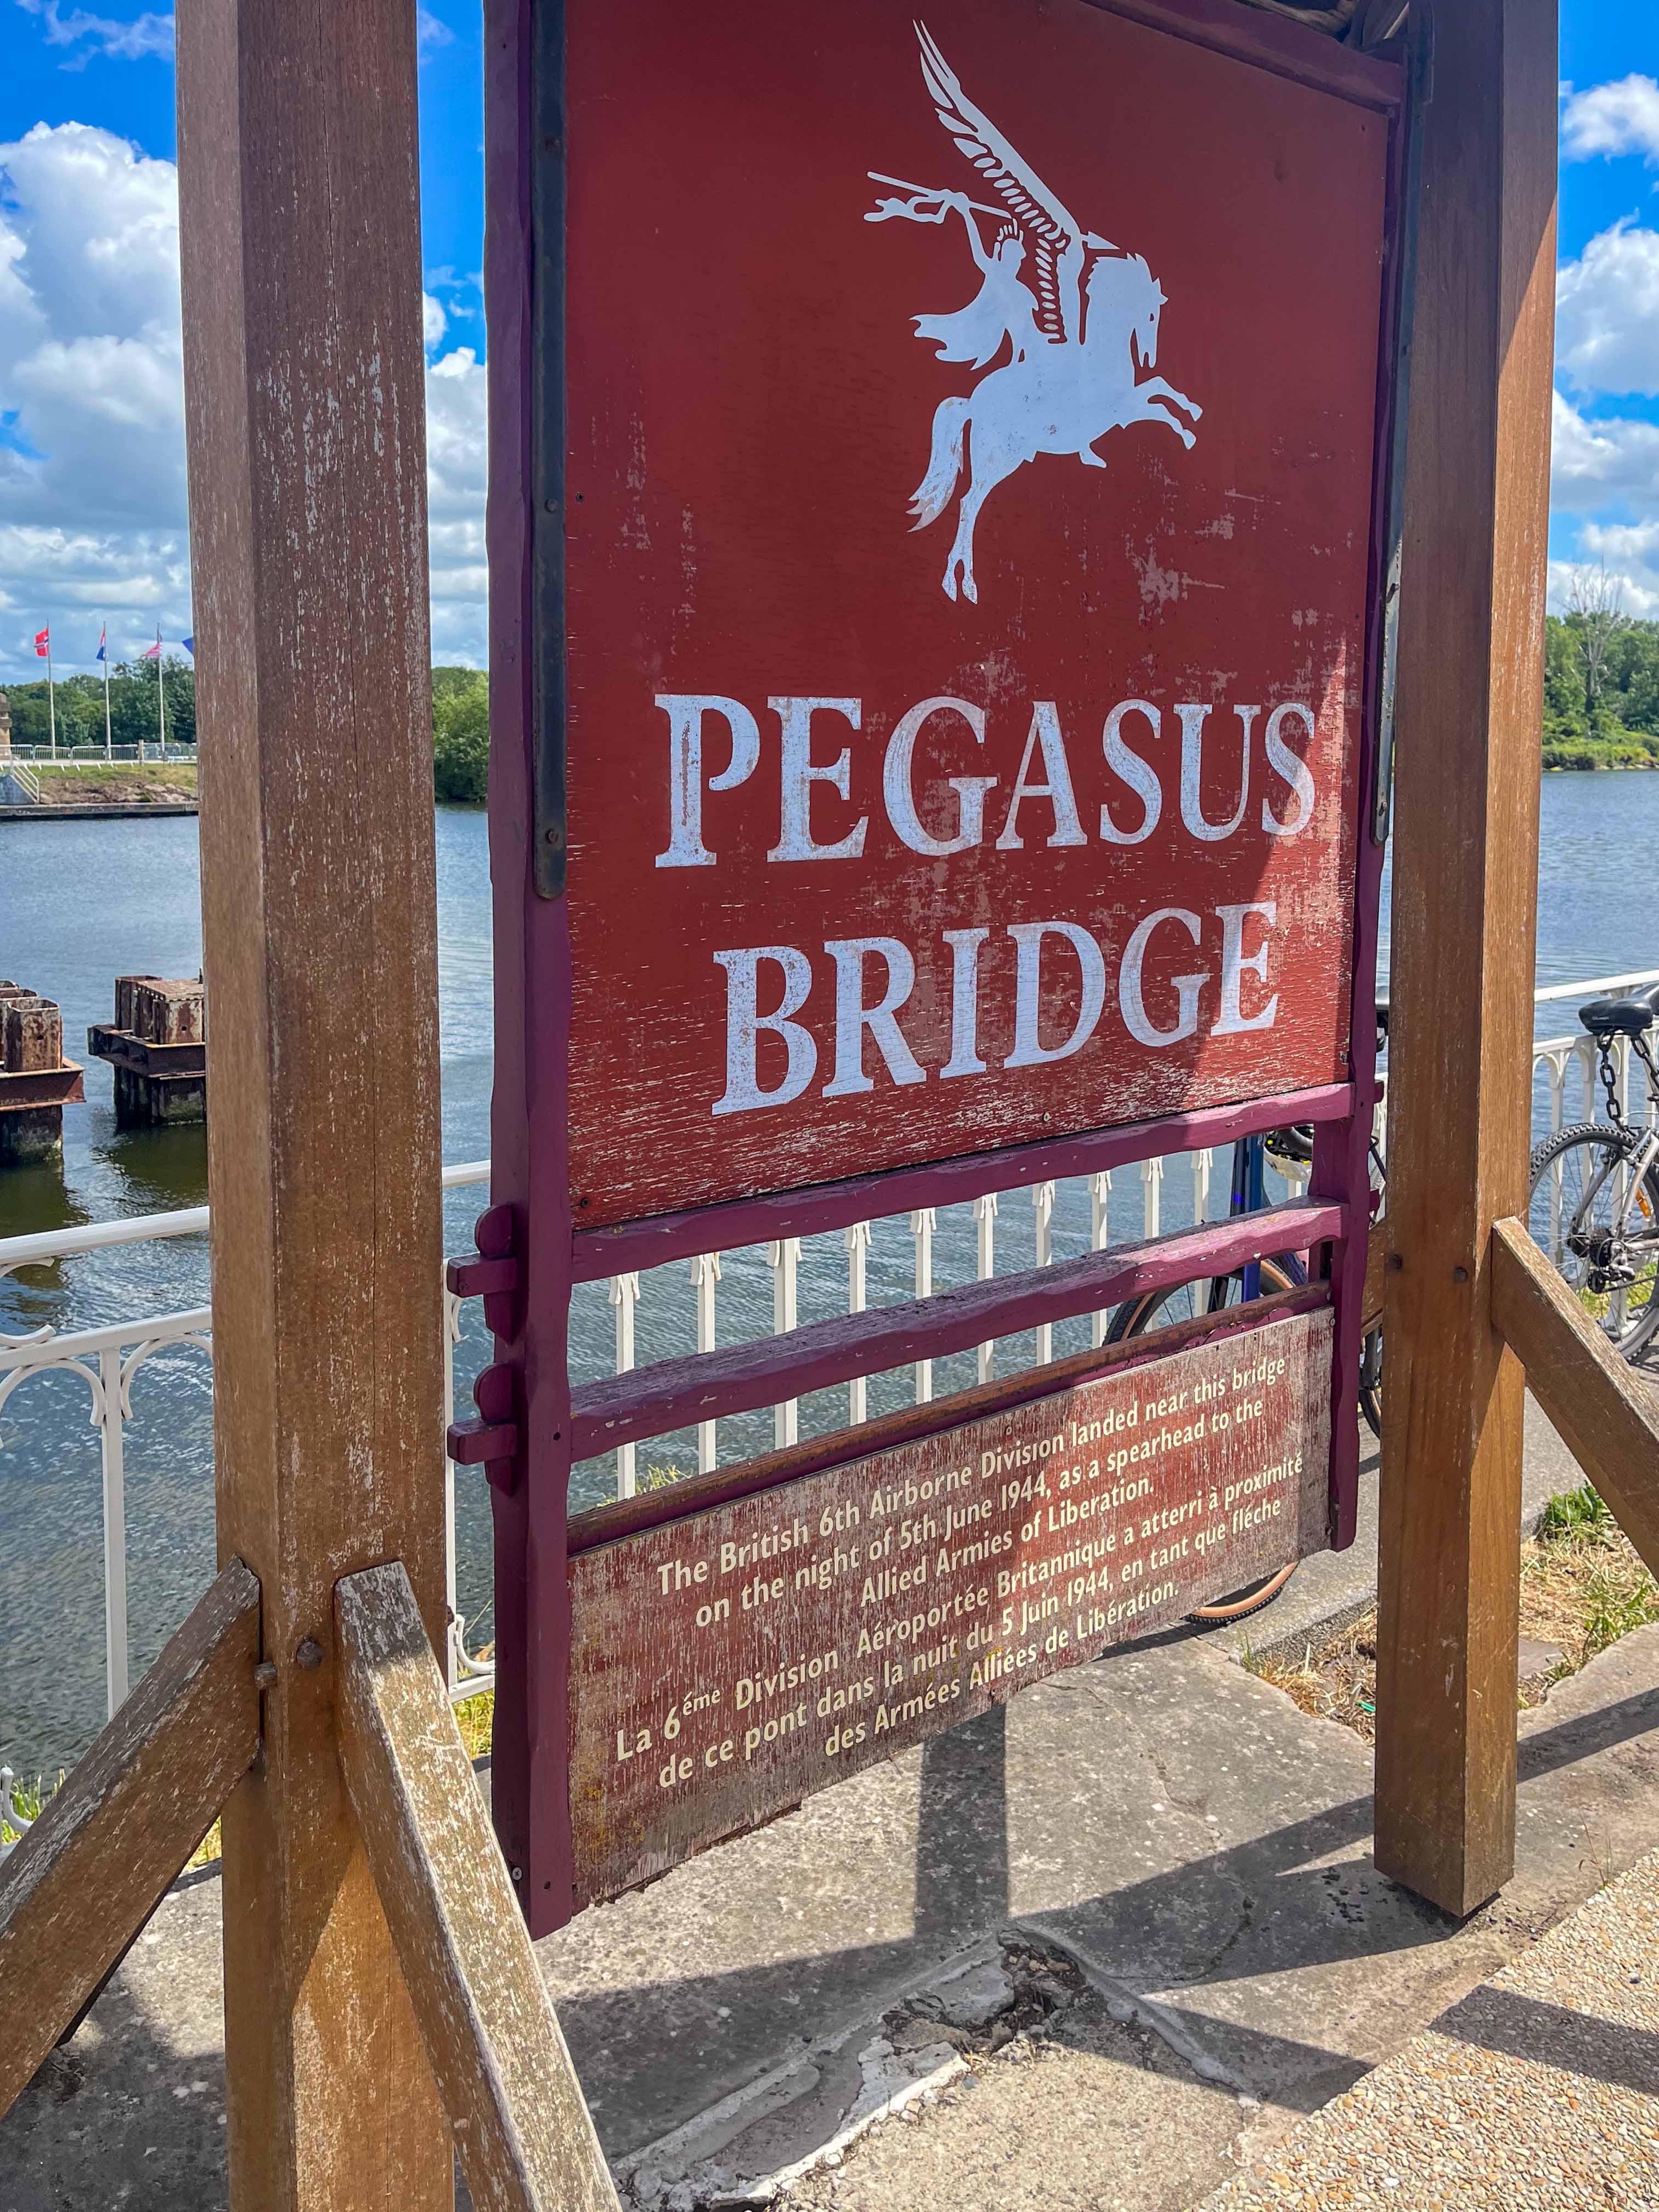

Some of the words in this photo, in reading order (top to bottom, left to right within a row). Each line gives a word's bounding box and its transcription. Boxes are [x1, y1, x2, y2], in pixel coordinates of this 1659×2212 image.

[654, 692, 1316, 868] PEGASUS
[711, 901, 1279, 1116] BRIDGE
[657, 1560, 708, 1596] The
[719, 1519, 809, 1574] British
[819, 1500, 861, 1537] 6th
[869, 1466, 972, 1519] Airborne
[981, 1434, 1064, 1479] Division
[1071, 1400, 1138, 1446] landed
[1144, 1392, 1188, 1423] near
[1193, 1373, 1226, 1405] this
[1232, 1357, 1285, 1391] bridge
[696, 1596, 730, 1628] on
[741, 1578, 784, 1611] the
[795, 1544, 860, 1590] night
[869, 1527, 892, 1561] of
[900, 1514, 936, 1550] 5th
[944, 1498, 992, 1541] June
[1001, 1471, 1052, 1511] 1944,
[1059, 1463, 1081, 1491] as
[1088, 1459, 1100, 1479] a
[1106, 1413, 1205, 1476] spearhead
[1211, 1412, 1230, 1434] to
[1235, 1397, 1263, 1427] the
[860, 1556, 927, 1607] Allied
[935, 1531, 1013, 1578] Armies
[1020, 1511, 1041, 1543] of
[1048, 1477, 1154, 1532] Liberation.
[617, 1728, 652, 1762] La
[736, 1649, 839, 1711] Division
[856, 1585, 989, 1658] Aéroportée
[997, 1536, 1116, 1598] Britannique
[1124, 1525, 1134, 1547] a
[1141, 1490, 1203, 1539] atterri
[1208, 1486, 1218, 1511] à
[1224, 1452, 1304, 1510] proximité
[659, 1754, 693, 1788] de
[704, 1738, 733, 1768] ce
[745, 1703, 807, 1761] pont
[816, 1674, 874, 1718] dans
[883, 1661, 904, 1688] la
[913, 1635, 958, 1677] nuit
[966, 1622, 994, 1650] du
[1001, 1605, 1013, 1636] 5
[1019, 1591, 1059, 1636] Juin
[1066, 1566, 1114, 1607] 1944,
[1121, 1558, 1143, 1581] en
[1150, 1538, 1188, 1571] tant
[1194, 1525, 1226, 1556] que
[825, 1722, 866, 1757] des
[874, 1678, 960, 1734] Armées
[968, 1643, 1037, 1690] Alliées
[1045, 1626, 1069, 1654] de
[1076, 1581, 1179, 1640] Libération.
